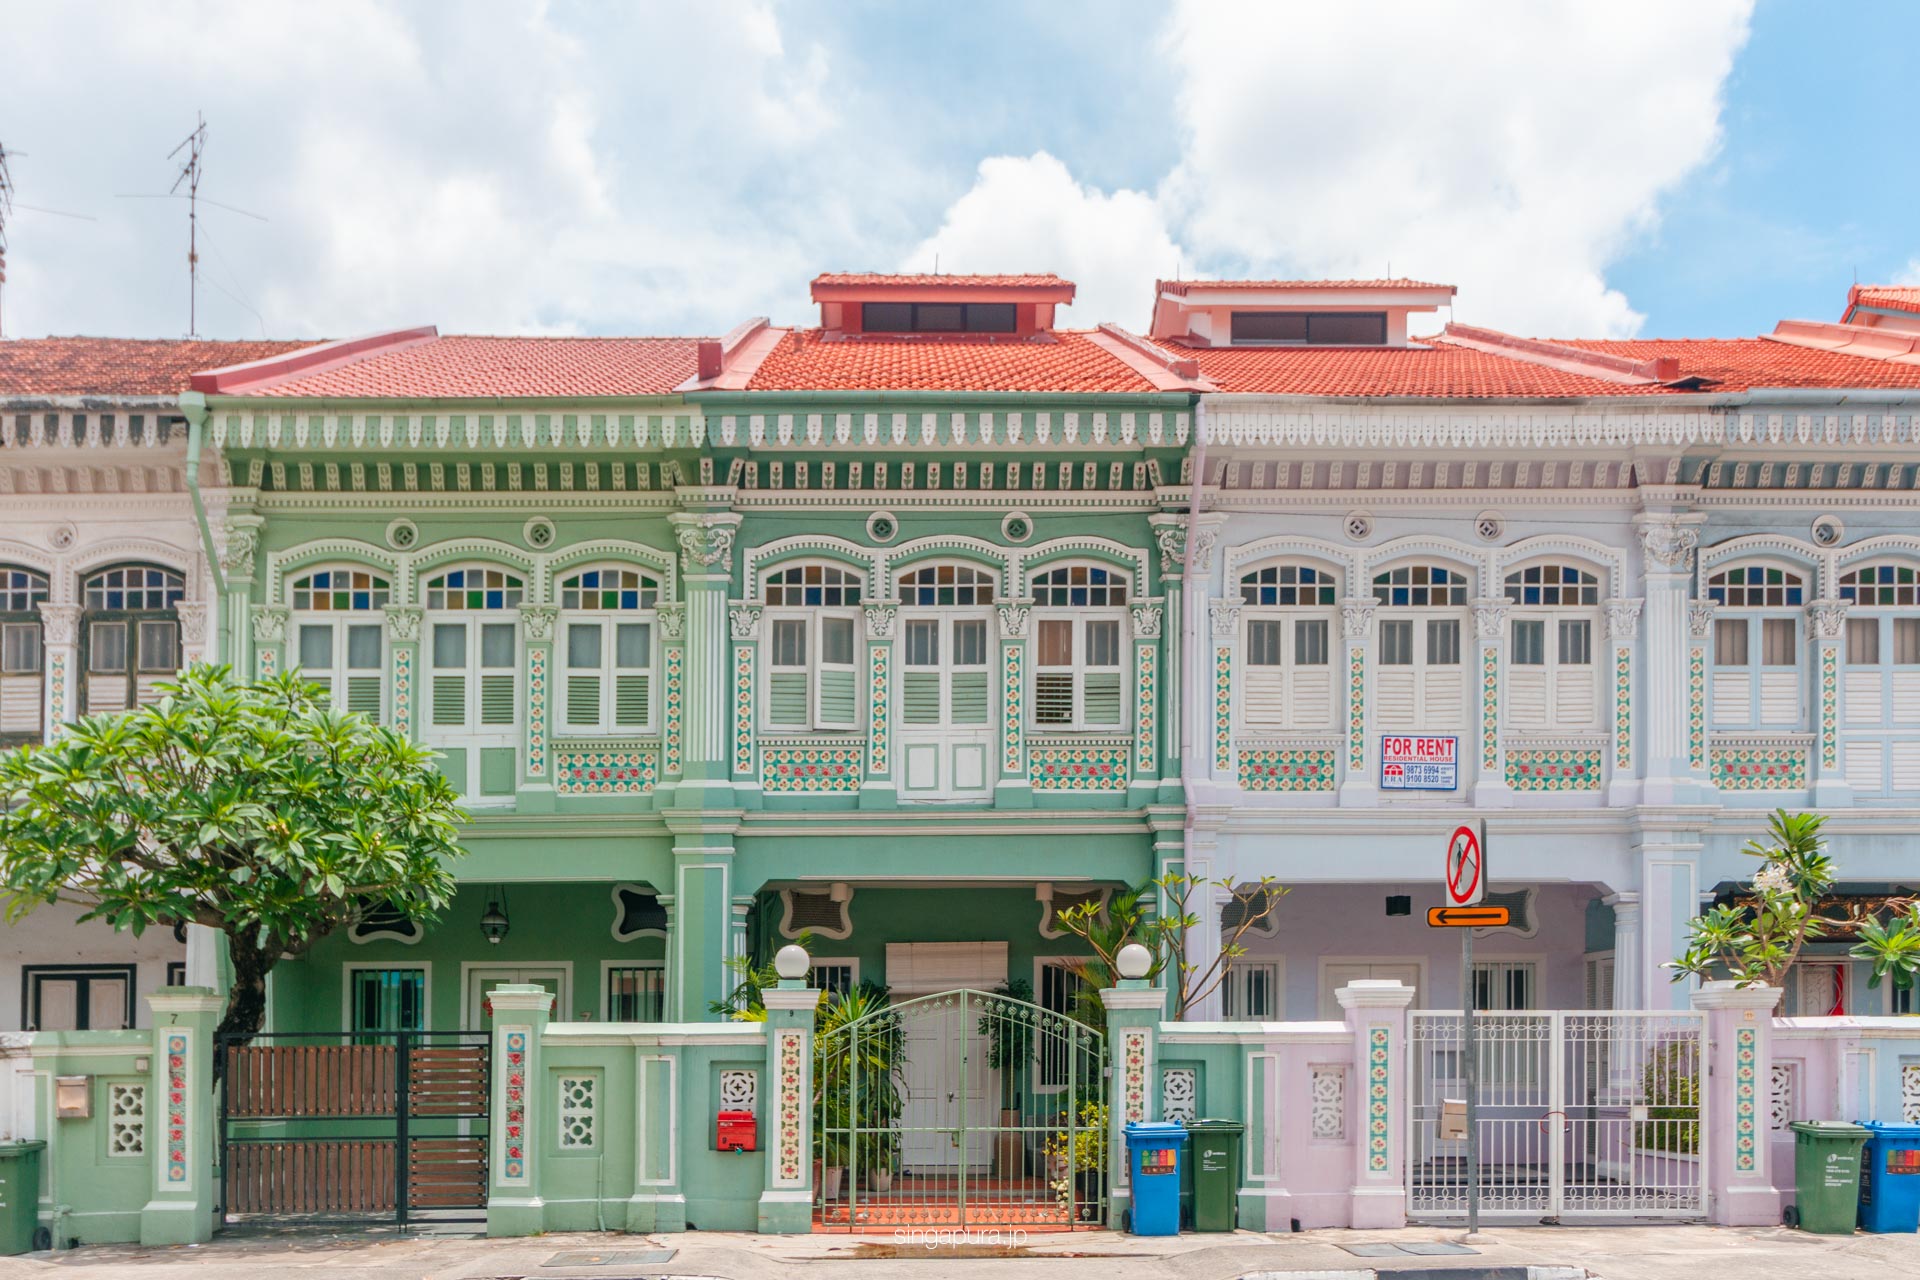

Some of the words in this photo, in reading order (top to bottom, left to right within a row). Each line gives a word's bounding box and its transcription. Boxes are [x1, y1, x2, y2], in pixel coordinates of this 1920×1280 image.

[1384, 738, 1412, 755] FOR
[1417, 739, 1454, 755] RENT
[1406, 765, 1422, 774] 9873
[1423, 765, 1439, 774] 6994
[789, 1009, 794, 1017] 9
[170, 1013, 178, 1024] 7
